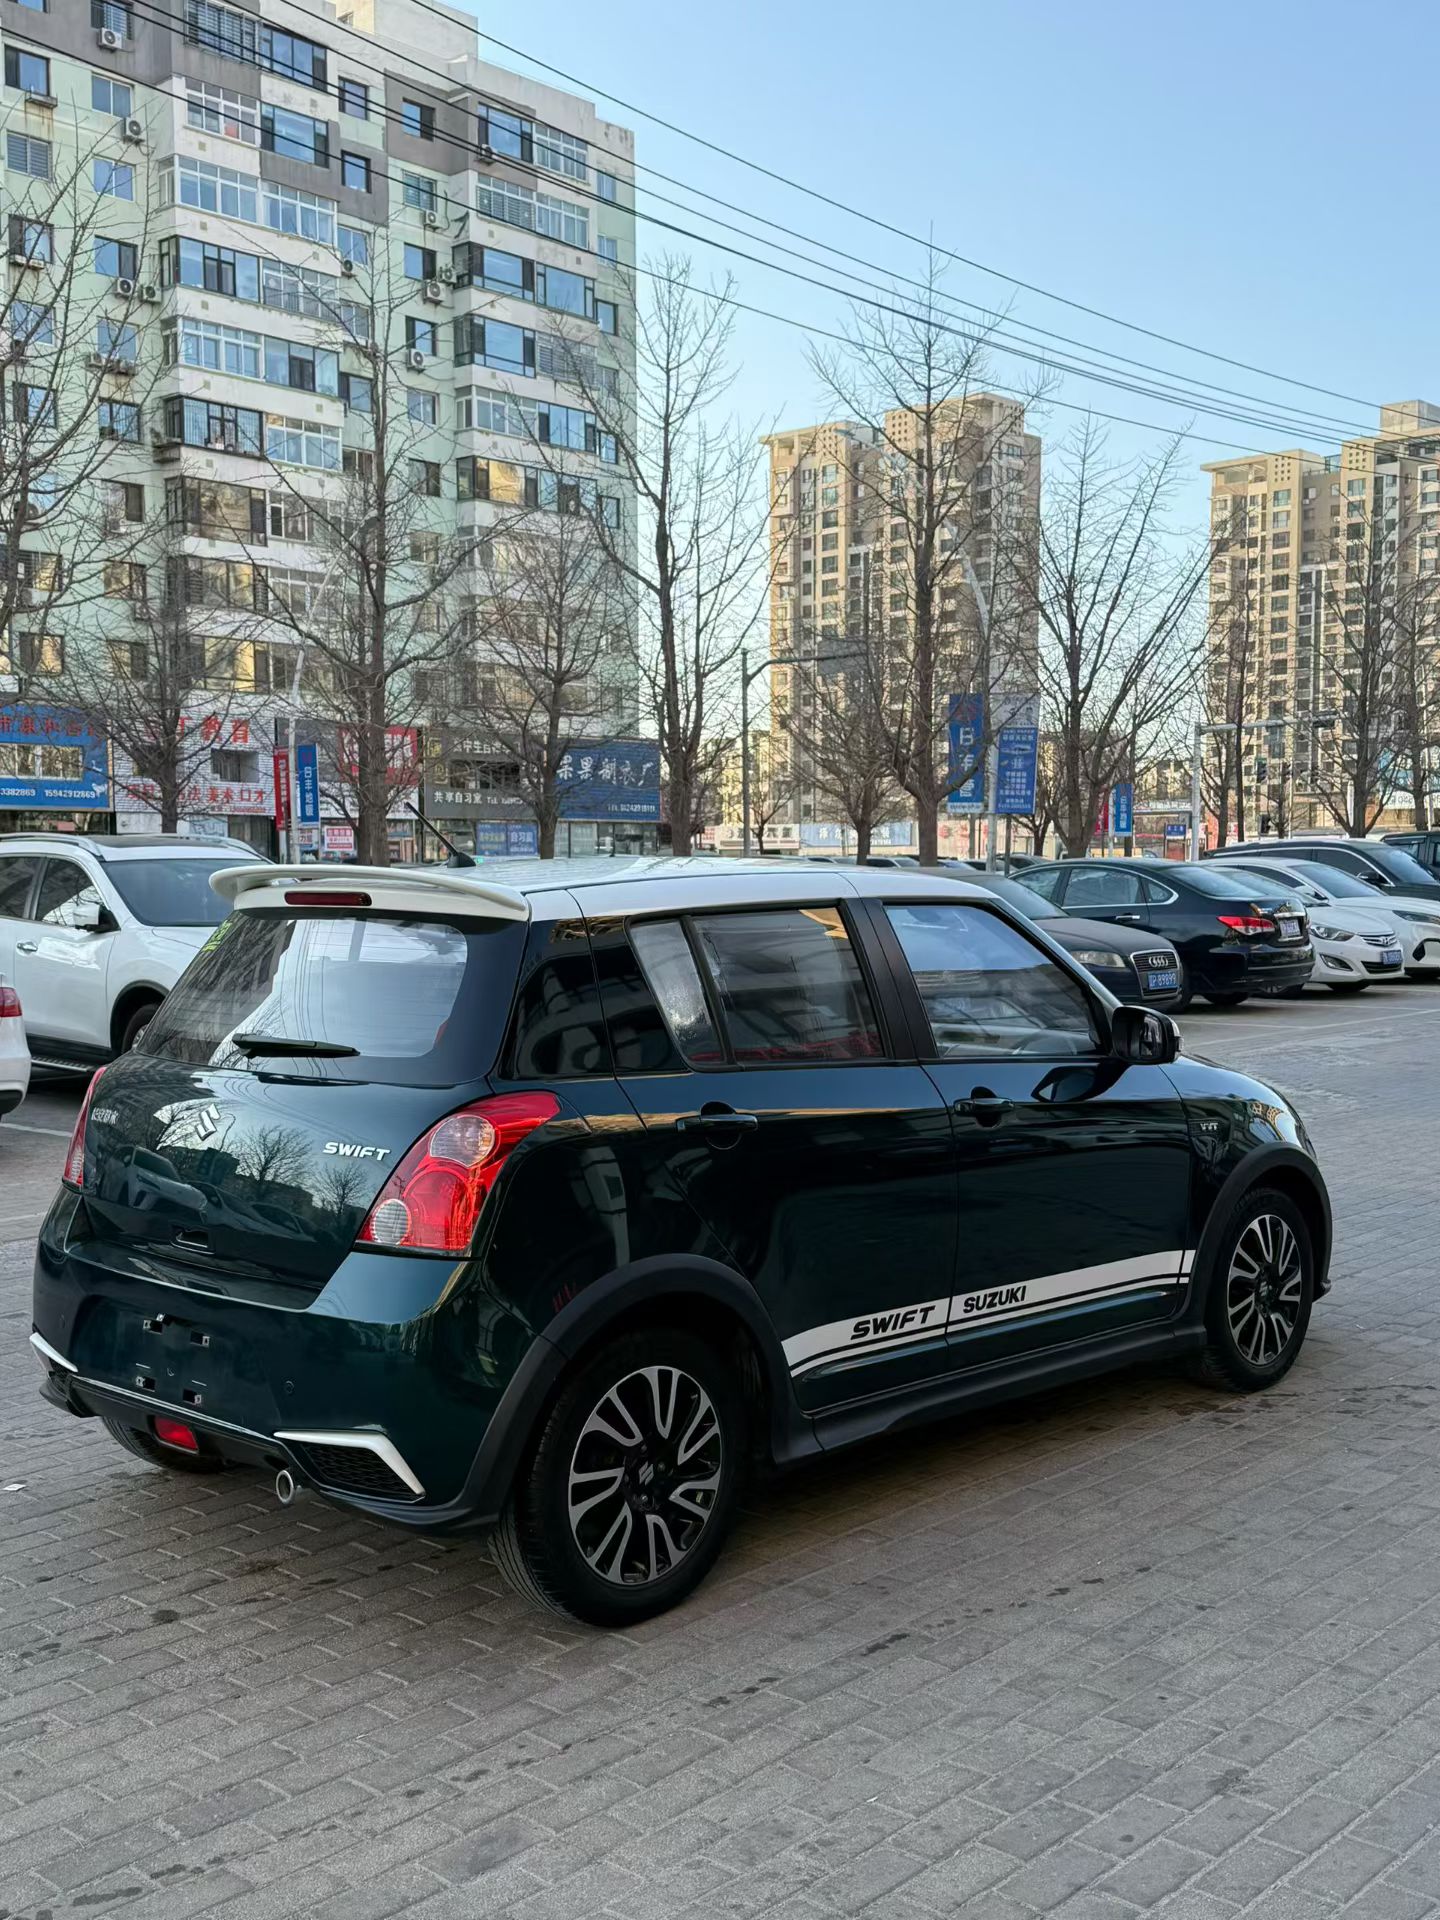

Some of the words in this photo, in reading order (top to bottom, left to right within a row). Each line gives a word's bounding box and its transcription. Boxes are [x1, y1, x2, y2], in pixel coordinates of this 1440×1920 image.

[433, 791, 482, 805] 共享自习室
[322, 1141, 391, 1161] SWIFT
[850, 1305, 936, 1340] SWIFT
[963, 1285, 1027, 1314] SUZUKI
